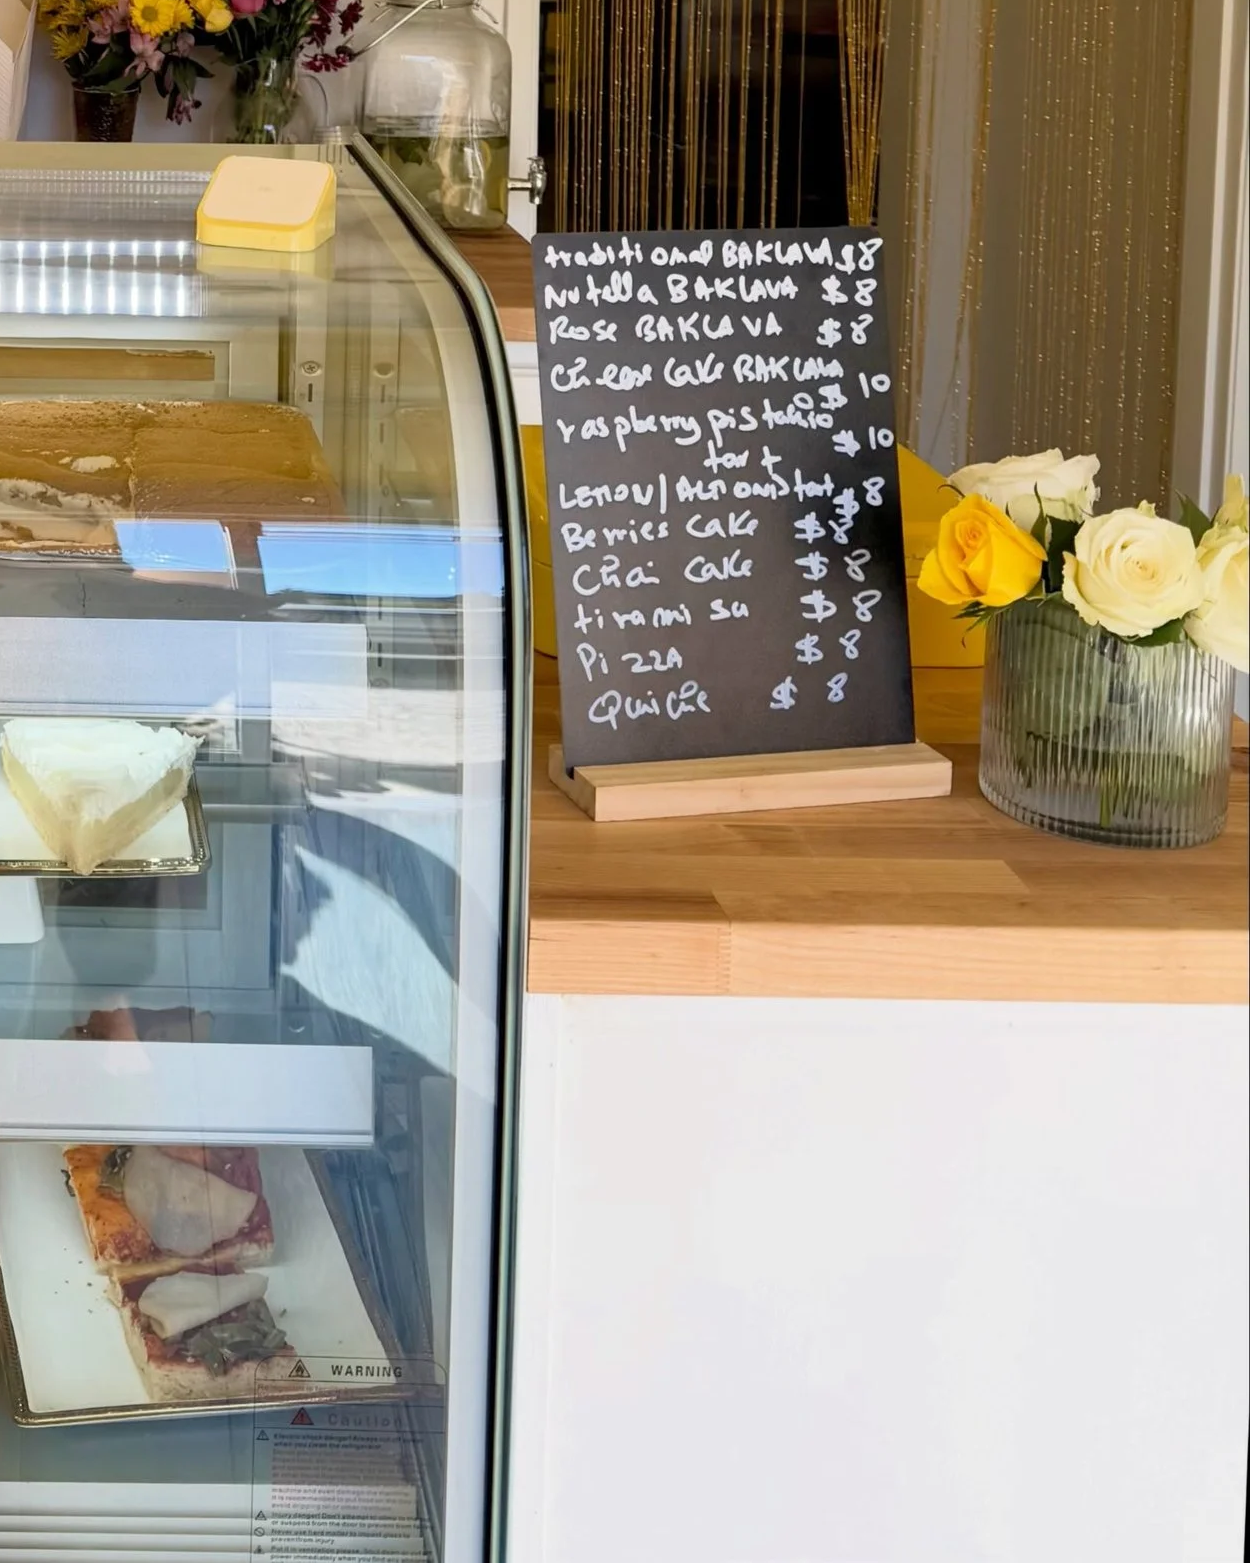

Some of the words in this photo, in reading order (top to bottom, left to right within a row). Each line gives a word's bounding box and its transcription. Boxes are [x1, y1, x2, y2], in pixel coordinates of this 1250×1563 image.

[722, 238, 832, 270] BAKLAVA
[666, 274, 799, 304] BAKLAVA
[549, 315, 619, 345] Rose
[635, 312, 783, 343] BAKLAVA
[332, 1364, 403, 1378] WARNING
[328, 1412, 402, 1428] Caution
